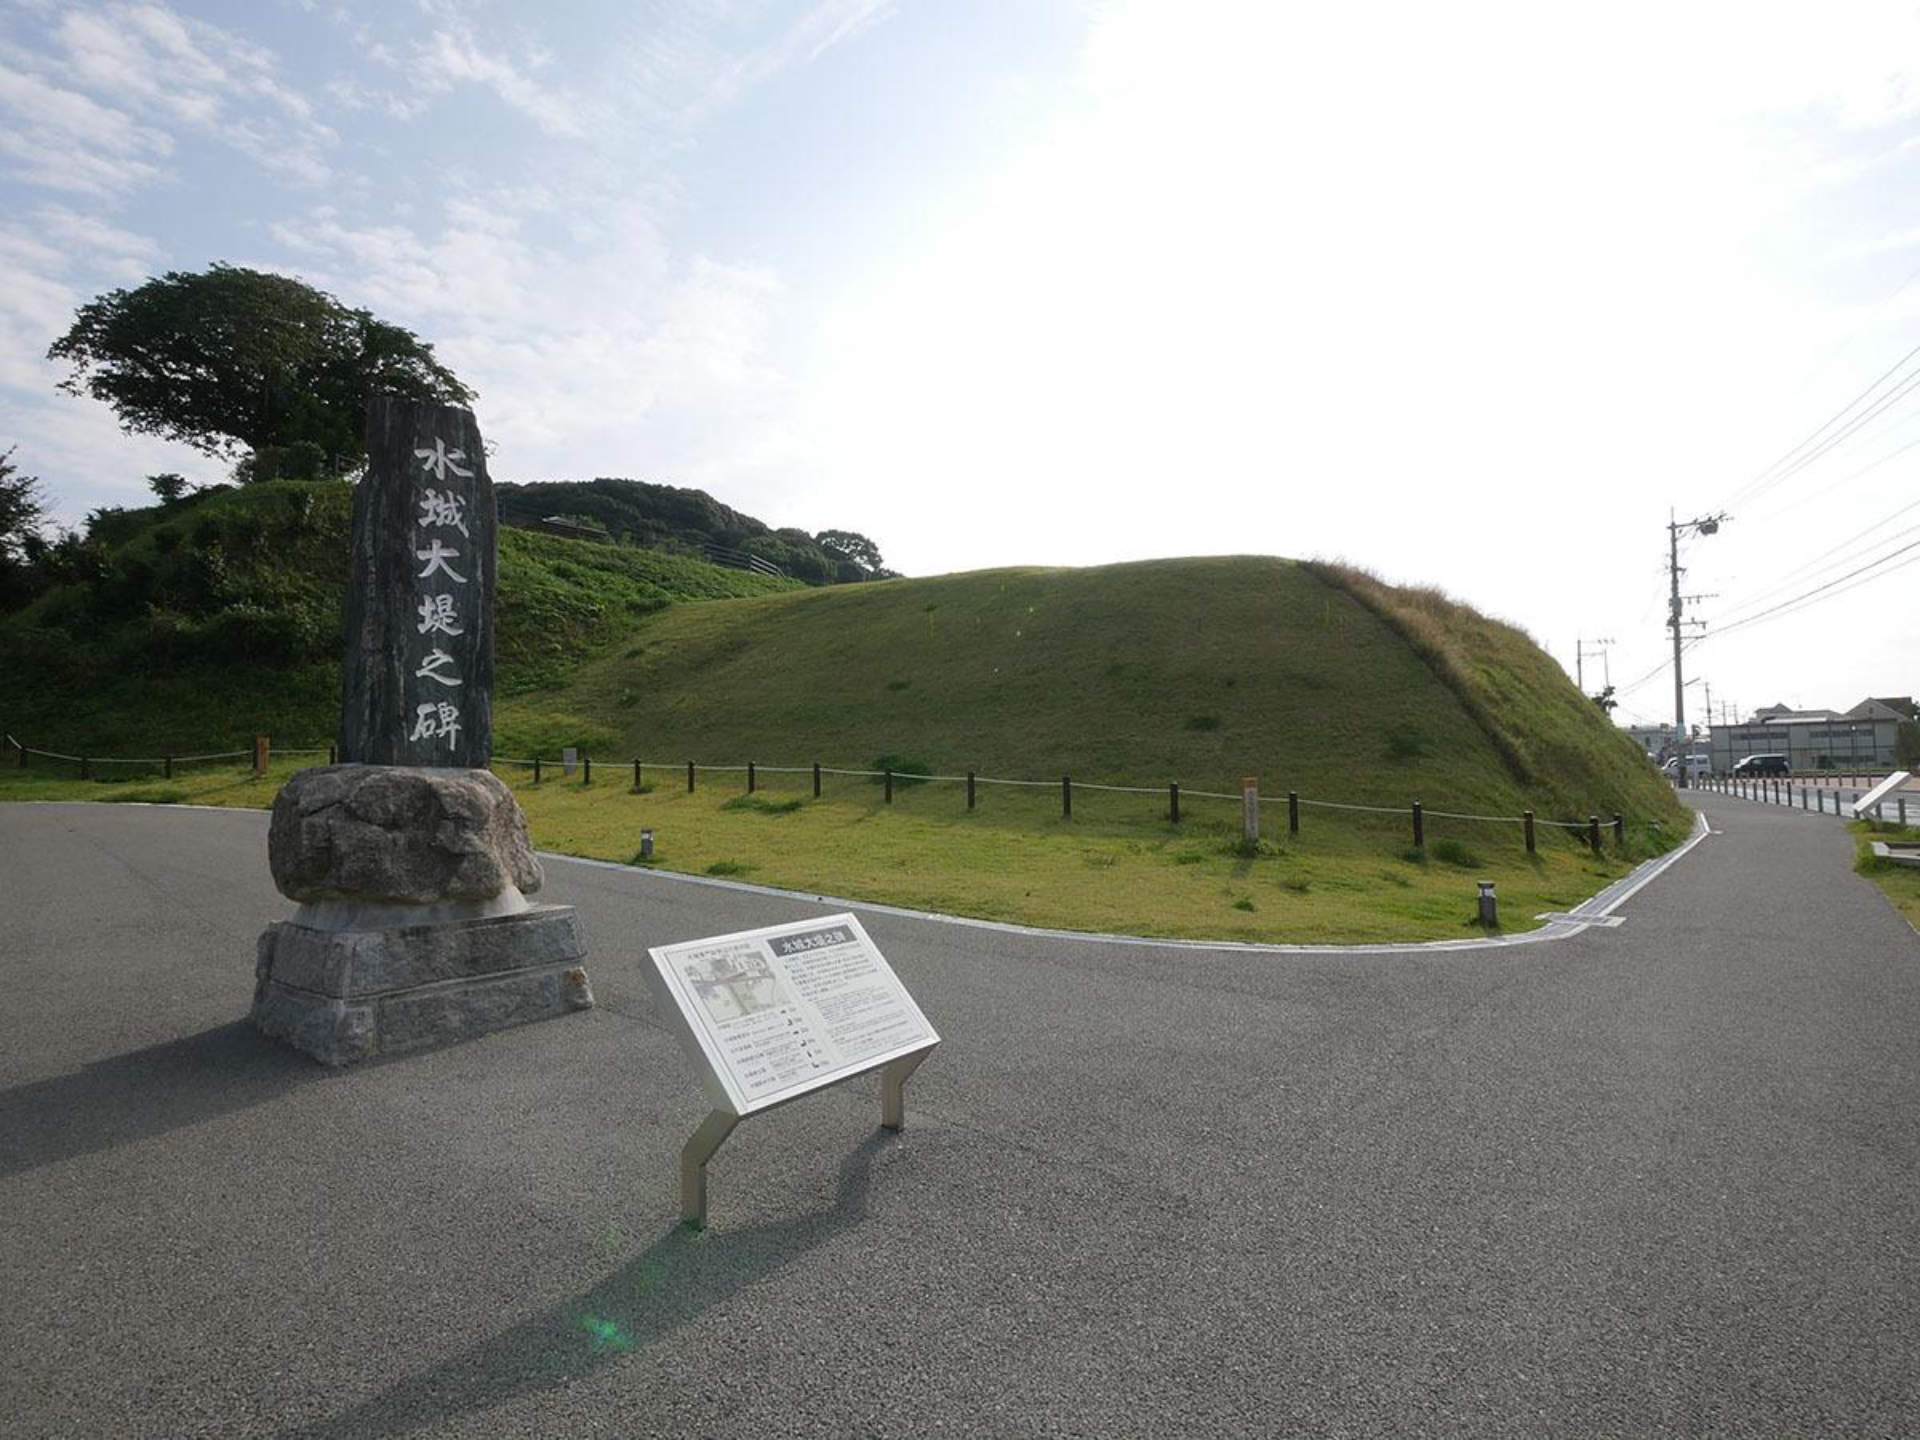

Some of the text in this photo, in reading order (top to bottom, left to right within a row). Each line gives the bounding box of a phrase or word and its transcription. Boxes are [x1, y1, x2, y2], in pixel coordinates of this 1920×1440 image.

[410, 437, 474, 751] 水城大堤之碑
